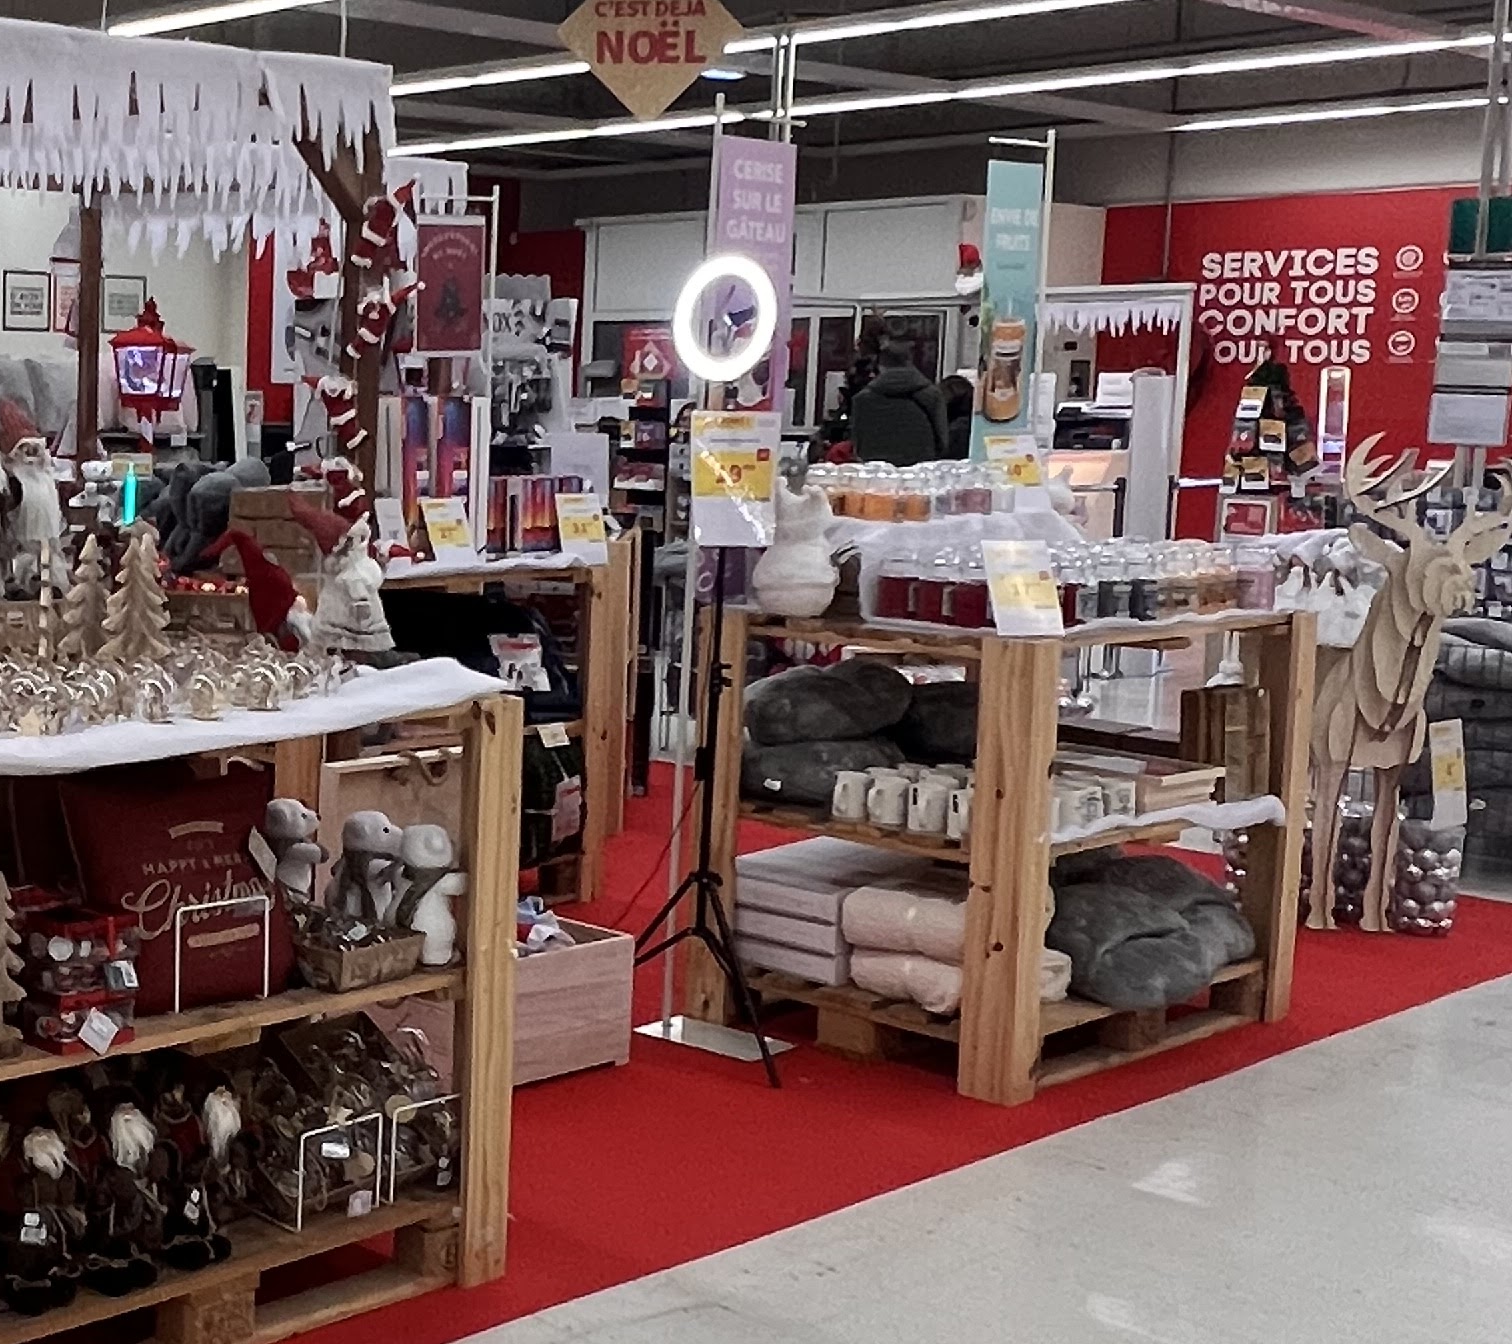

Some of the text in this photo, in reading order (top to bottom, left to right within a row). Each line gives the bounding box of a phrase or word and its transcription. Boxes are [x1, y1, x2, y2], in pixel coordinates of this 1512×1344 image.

[594, 0, 652, 18] C'EST
[595, 19, 708, 65] NOËL
[733, 159, 784, 185] CERISE
[732, 190, 782, 214] SUR LE
[726, 215, 786, 244] GÂTEAU
[1201, 246, 1380, 279] SERVICES
[1199, 279, 1377, 307] POUR TOUS
[1198, 307, 1374, 336] CONFORT
[1285, 339, 1372, 364] TOUS
